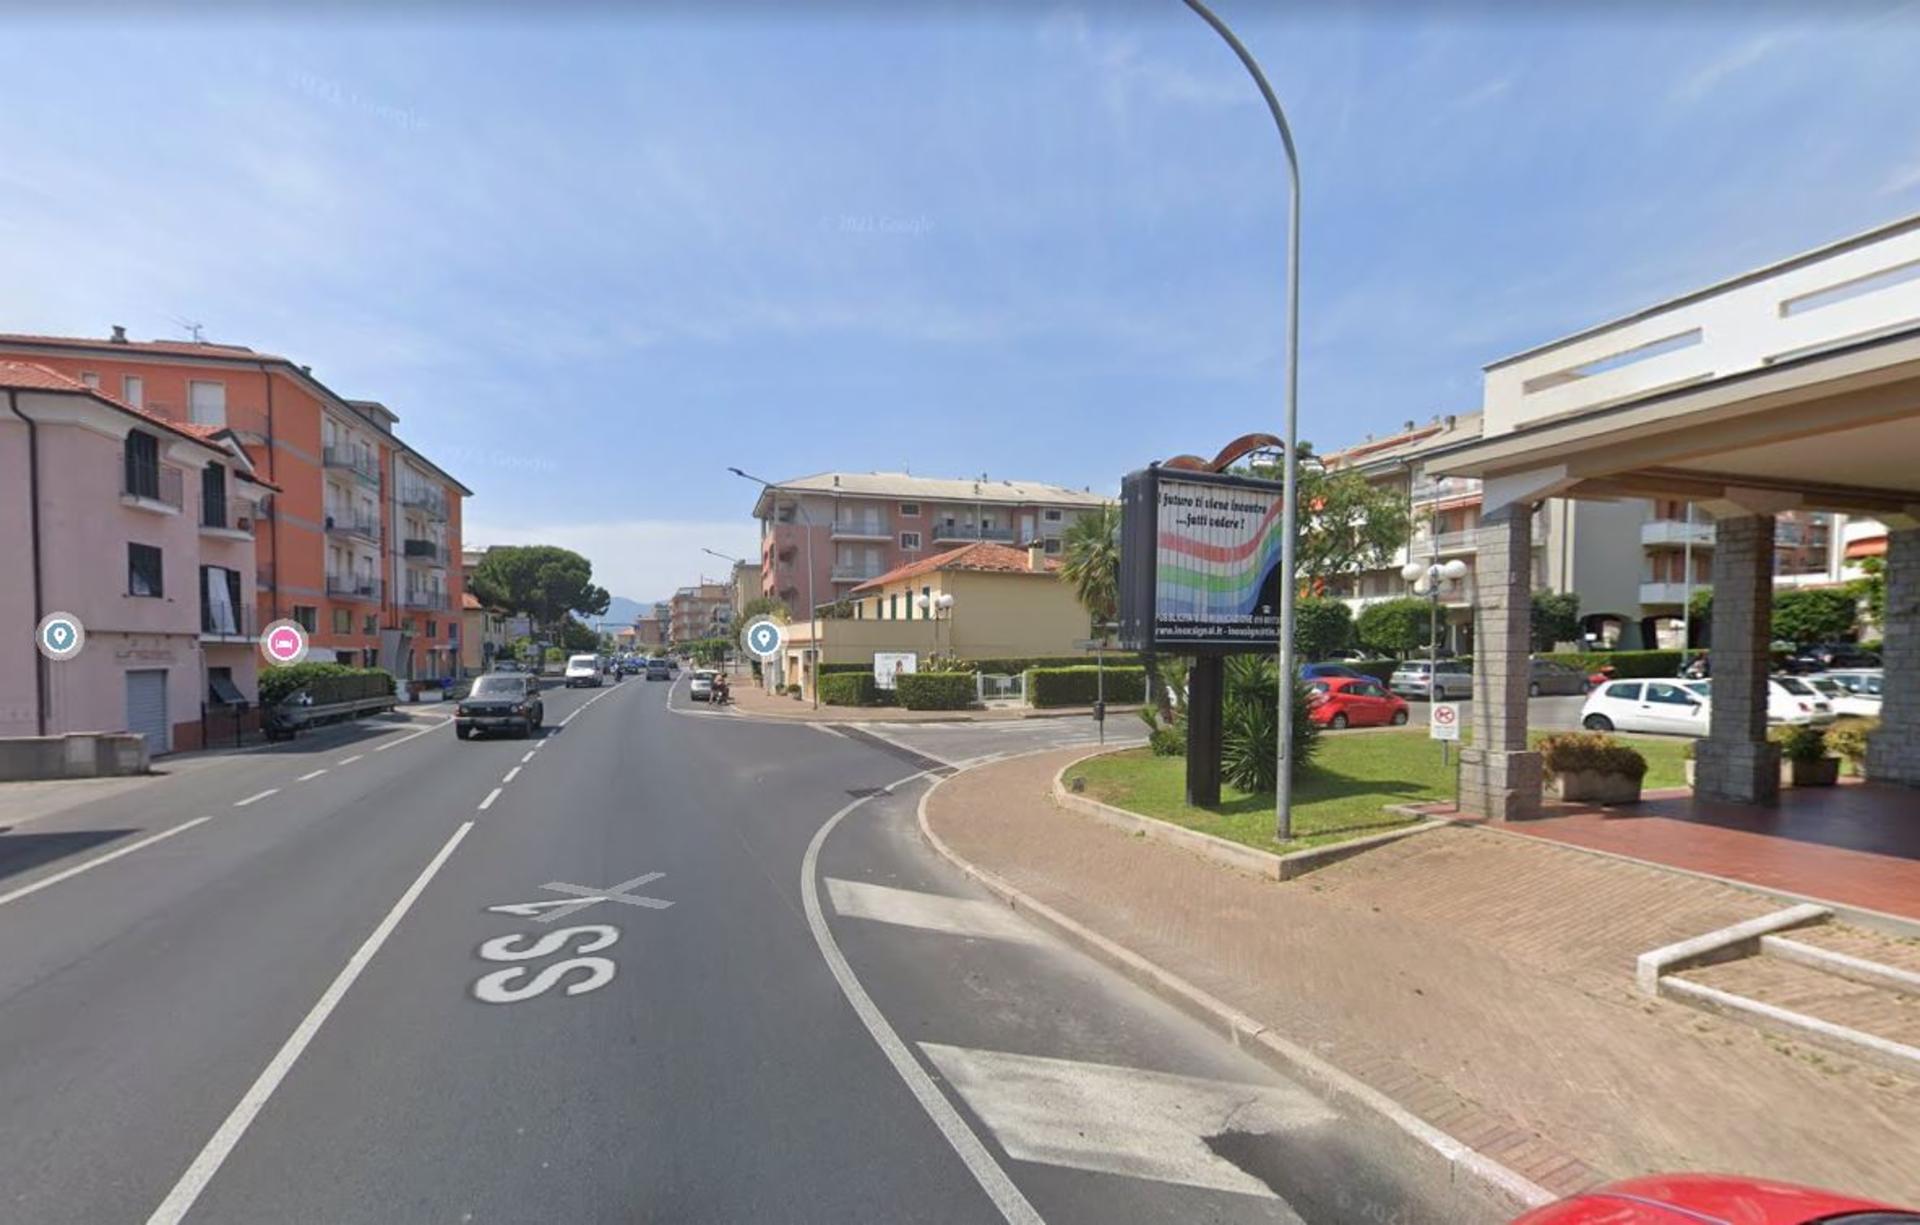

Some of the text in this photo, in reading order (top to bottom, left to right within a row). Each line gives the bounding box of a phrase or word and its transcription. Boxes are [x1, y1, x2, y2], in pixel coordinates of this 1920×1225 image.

[1163, 492, 1194, 507] futuro
[1195, 496, 1203, 508] ti
[1205, 497, 1229, 510] viene
[1209, 516, 1239, 529] vedere
